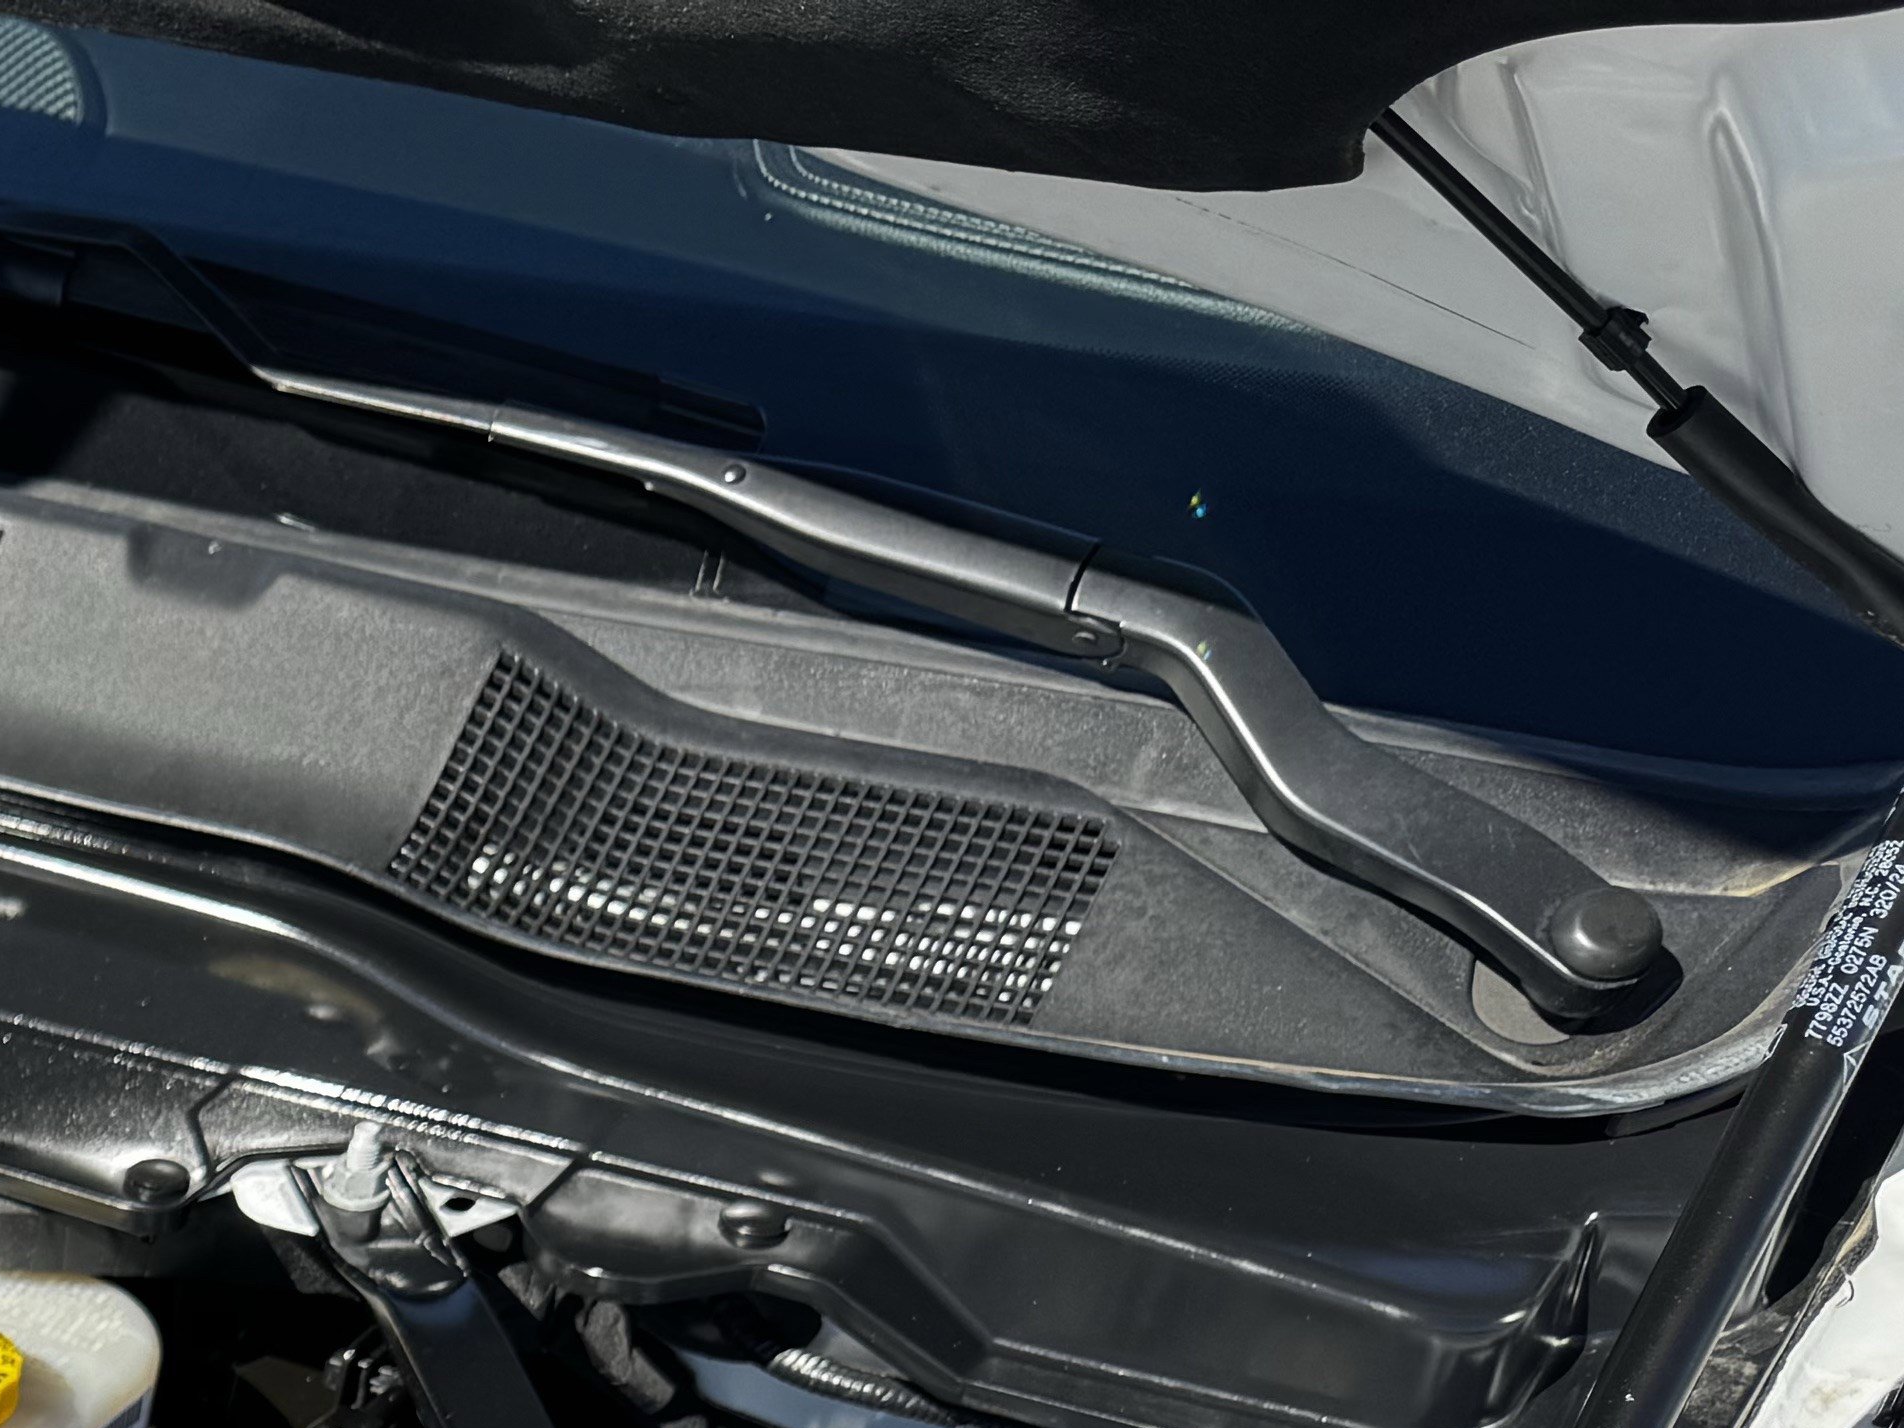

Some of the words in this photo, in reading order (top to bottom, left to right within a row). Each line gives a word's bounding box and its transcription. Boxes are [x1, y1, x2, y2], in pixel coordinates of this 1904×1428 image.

[1805, 982, 1850, 1040] 7798ZZ
[1840, 925, 1880, 976] 0275N
[1826, 953, 1888, 1048] 55372572AB
